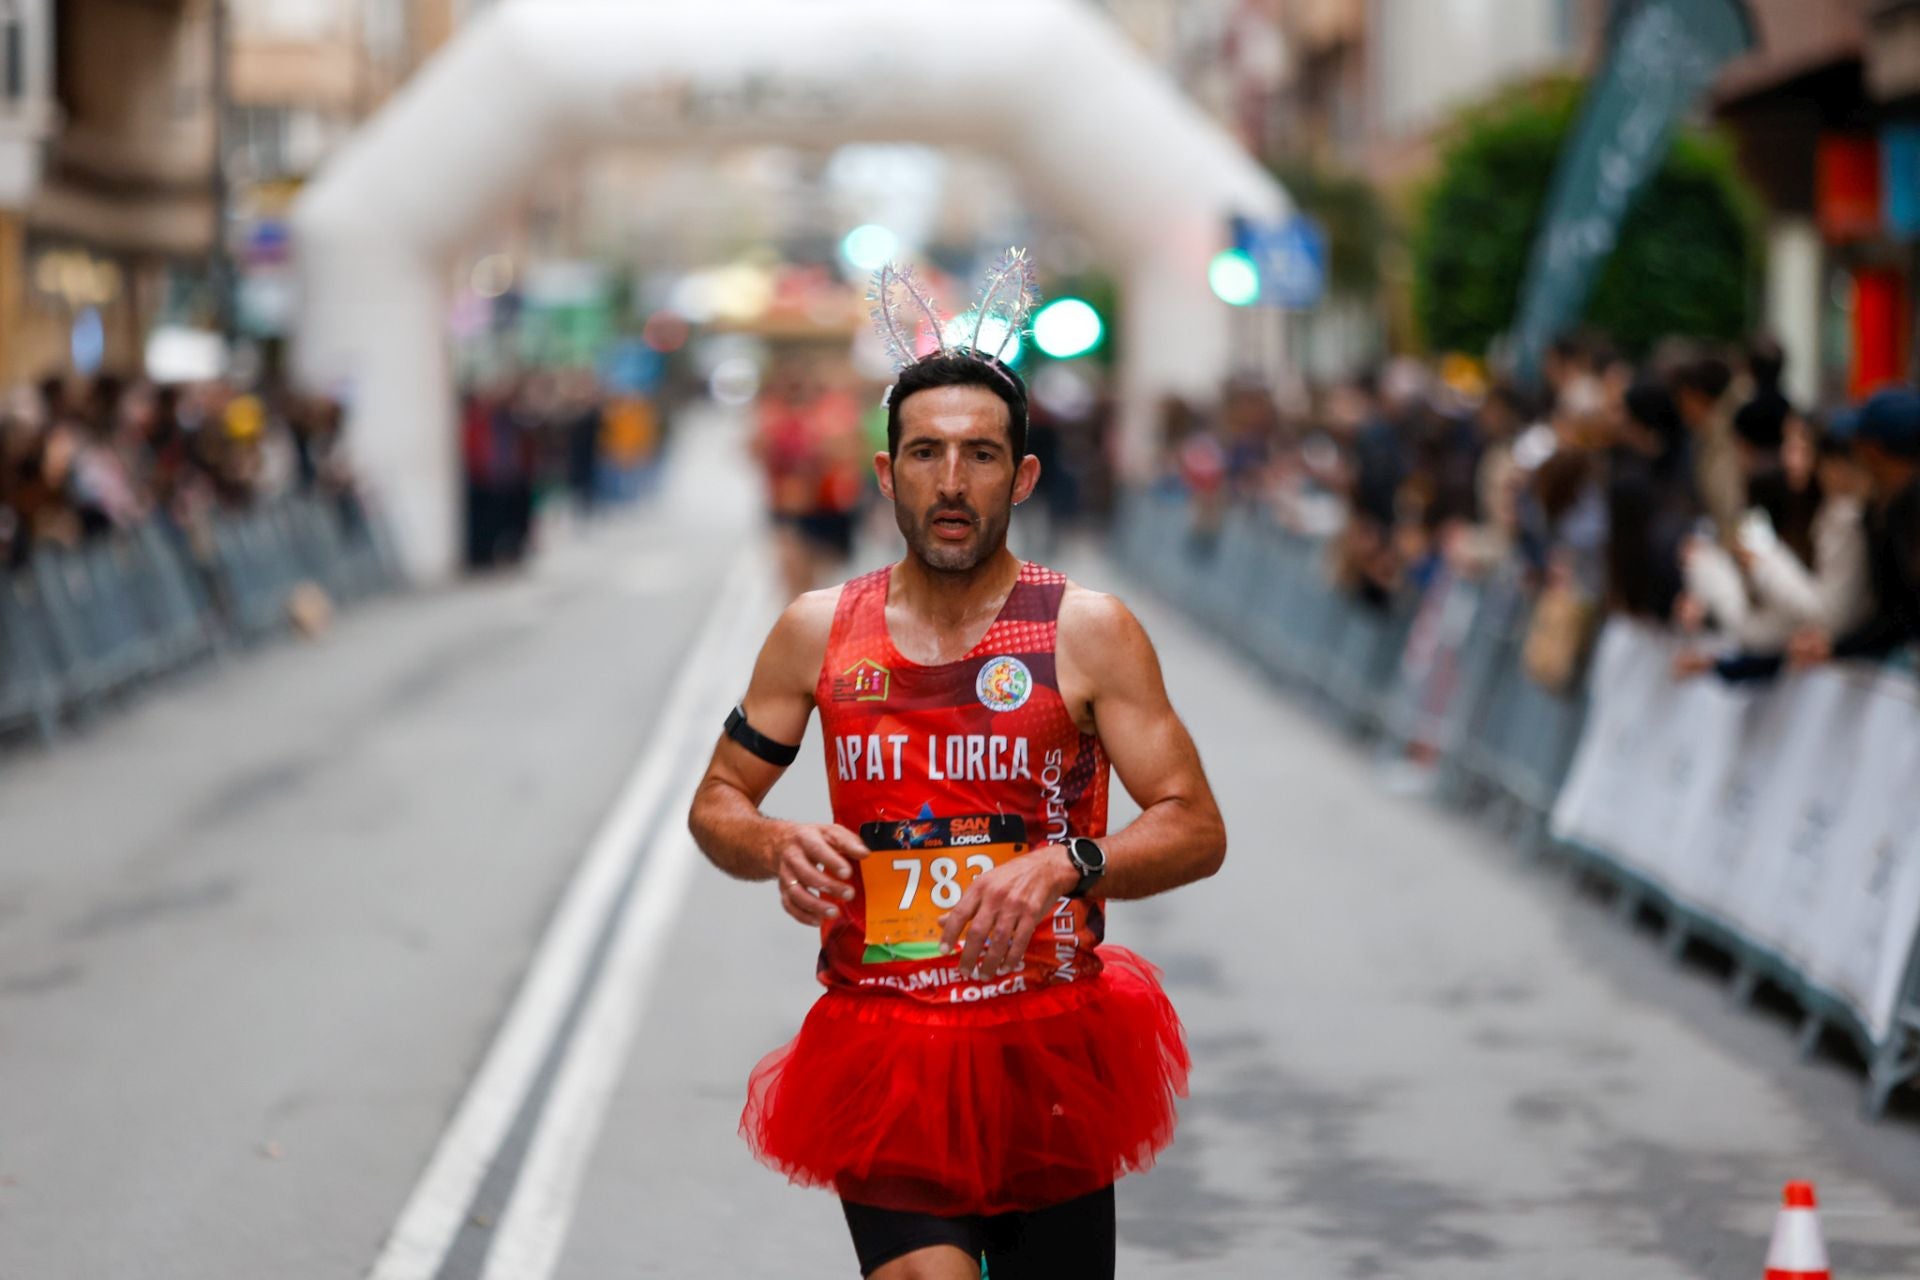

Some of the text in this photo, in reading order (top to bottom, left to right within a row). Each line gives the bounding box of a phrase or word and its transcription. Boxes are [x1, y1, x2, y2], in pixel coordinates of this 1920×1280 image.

[835, 734, 1032, 781] APAT LORCA
[1041, 748, 1069, 846] UEÑOS
[950, 816, 990, 831] SAN
[950, 834, 991, 846] LORCA
[950, 975, 1027, 1003] LORCA
